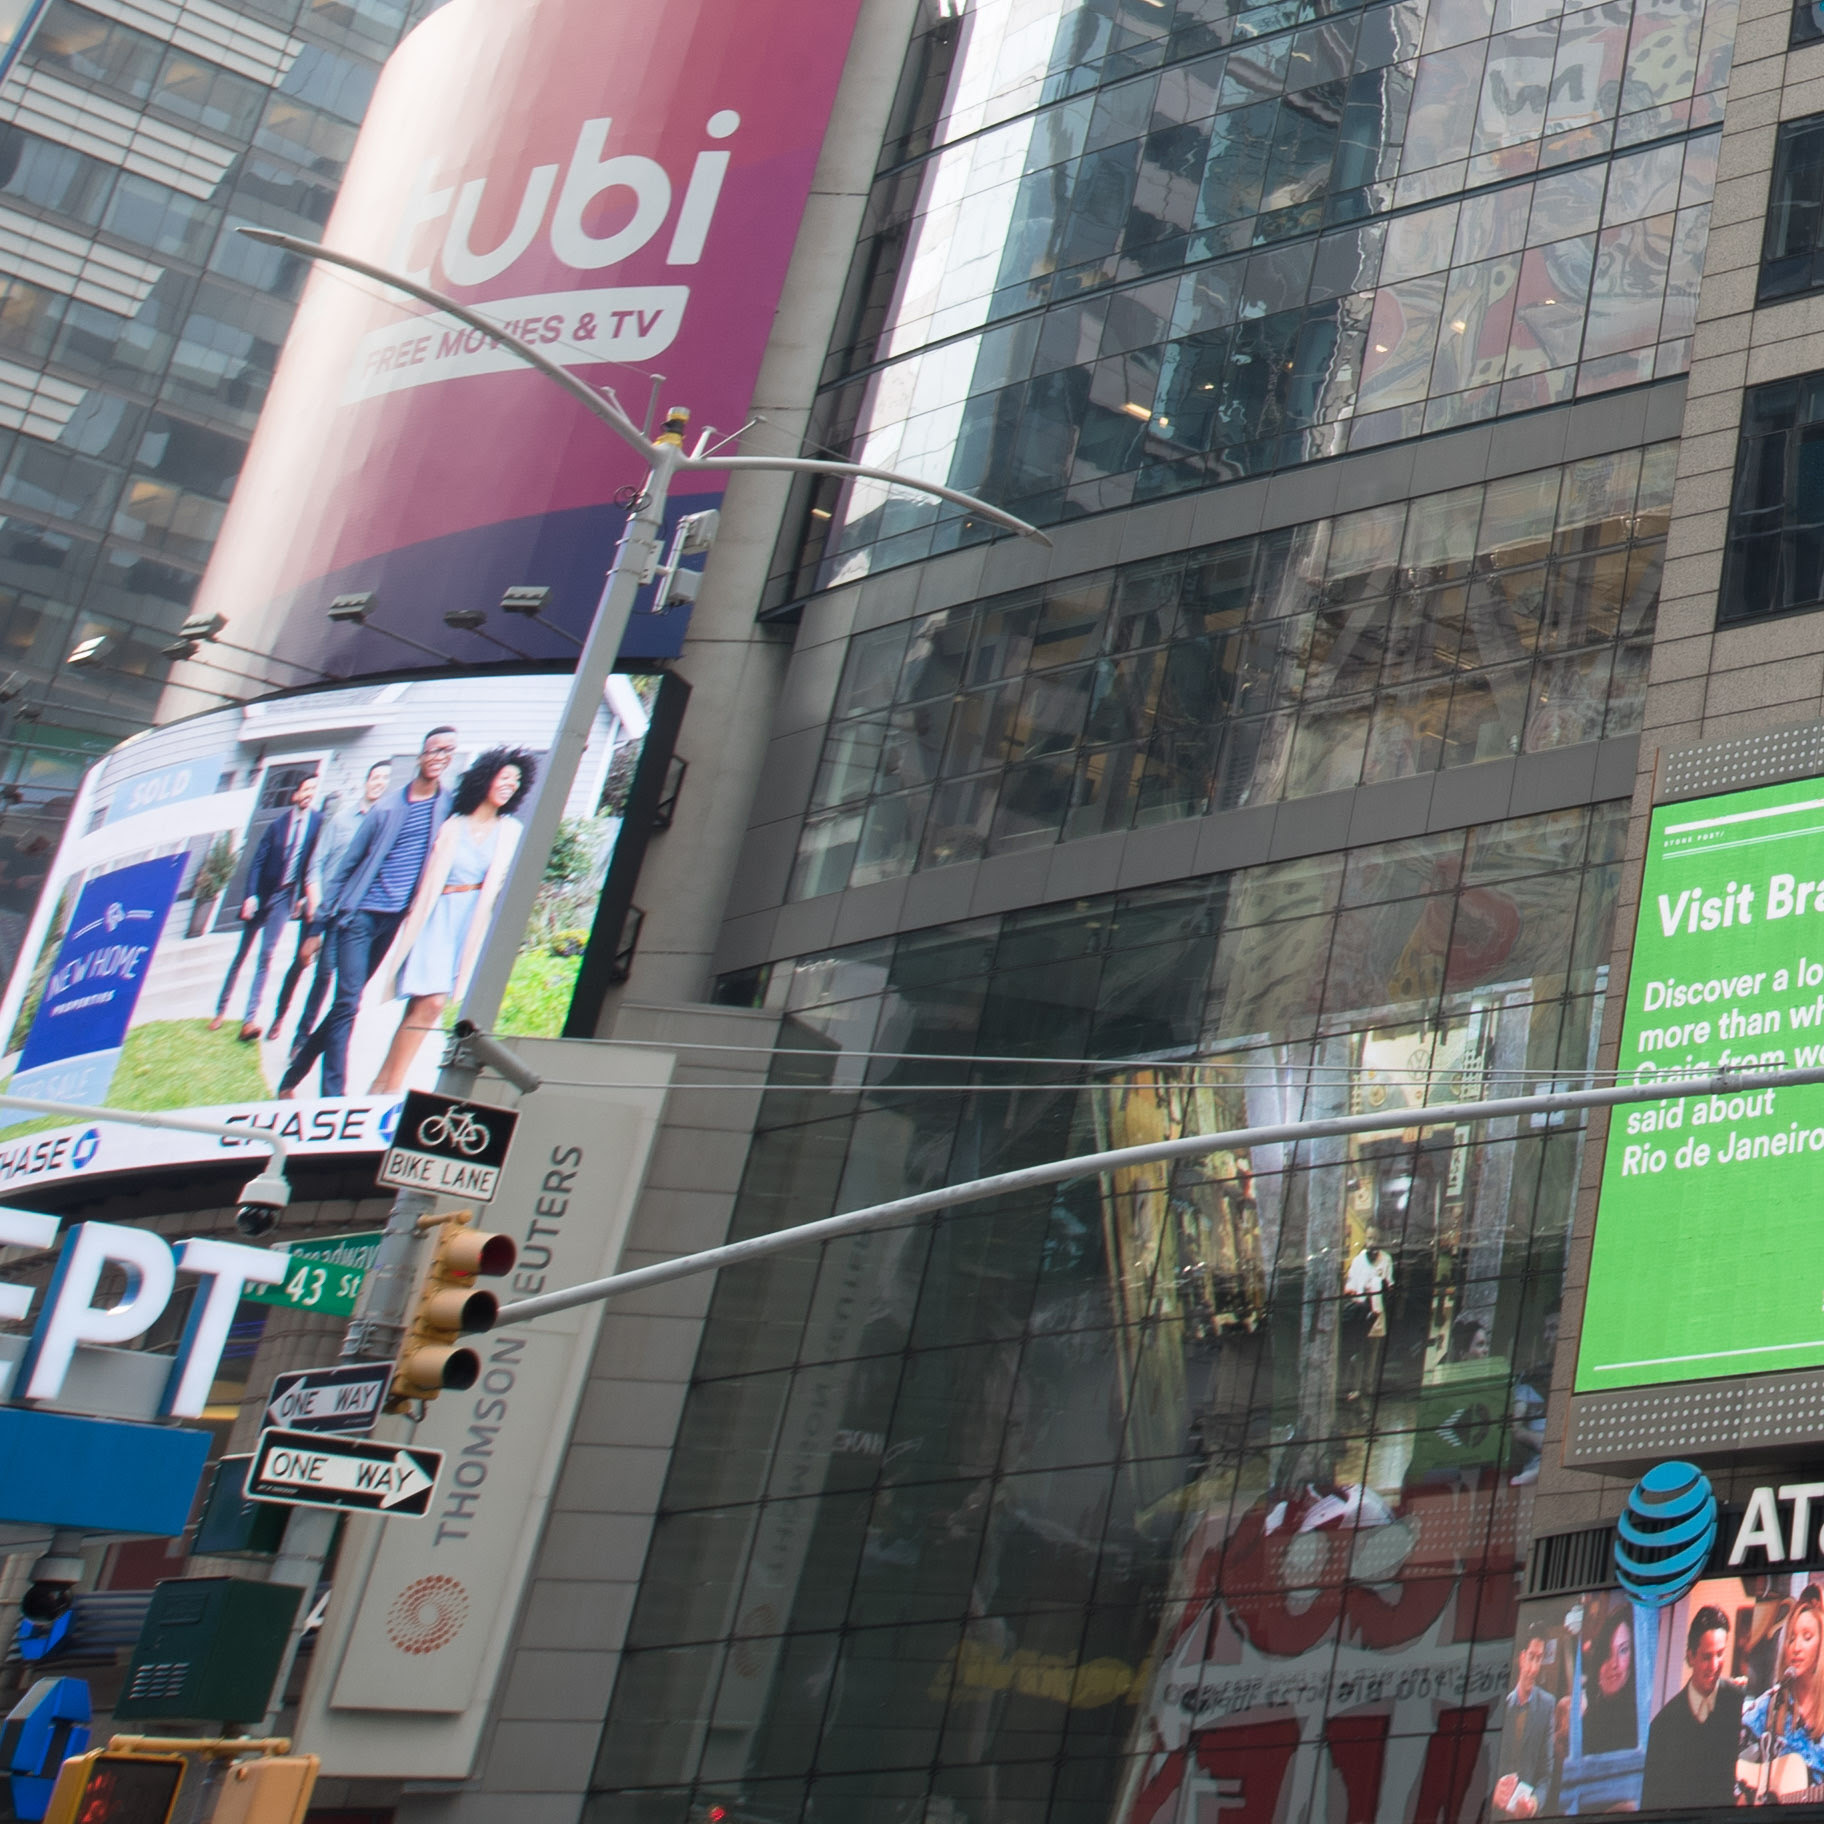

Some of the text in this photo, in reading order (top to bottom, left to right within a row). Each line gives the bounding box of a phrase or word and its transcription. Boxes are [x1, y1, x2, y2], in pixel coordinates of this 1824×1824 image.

[383, 109, 741, 302] tubi
[572, 312, 597, 342] &
[610, 309, 665, 339] TV
[128, 769, 191, 811] SOLD
[1657, 880, 1755, 937] Visit
[46, 944, 149, 1003] NEW HOME
[1643, 971, 1766, 1012] Discover
[1772, 968, 1789, 992] a
[1638, 1021, 1711, 1052] more
[1719, 1007, 1781, 1040] than
[219, 1107, 373, 1147] CHASE
[1626, 1088, 1776, 1135] said about
[390, 1153, 495, 1192] BIKE LANE
[1621, 1143, 1667, 1177] Rio
[1675, 1137, 1711, 1169] de
[285, 1265, 328, 1307] 43
[336, 1273, 362, 1299] St
[281, 1384, 378, 1419] ONE WAY
[432, 1336, 527, 1547] THOMSON
[272, 1452, 416, 1494] ONE WAY
